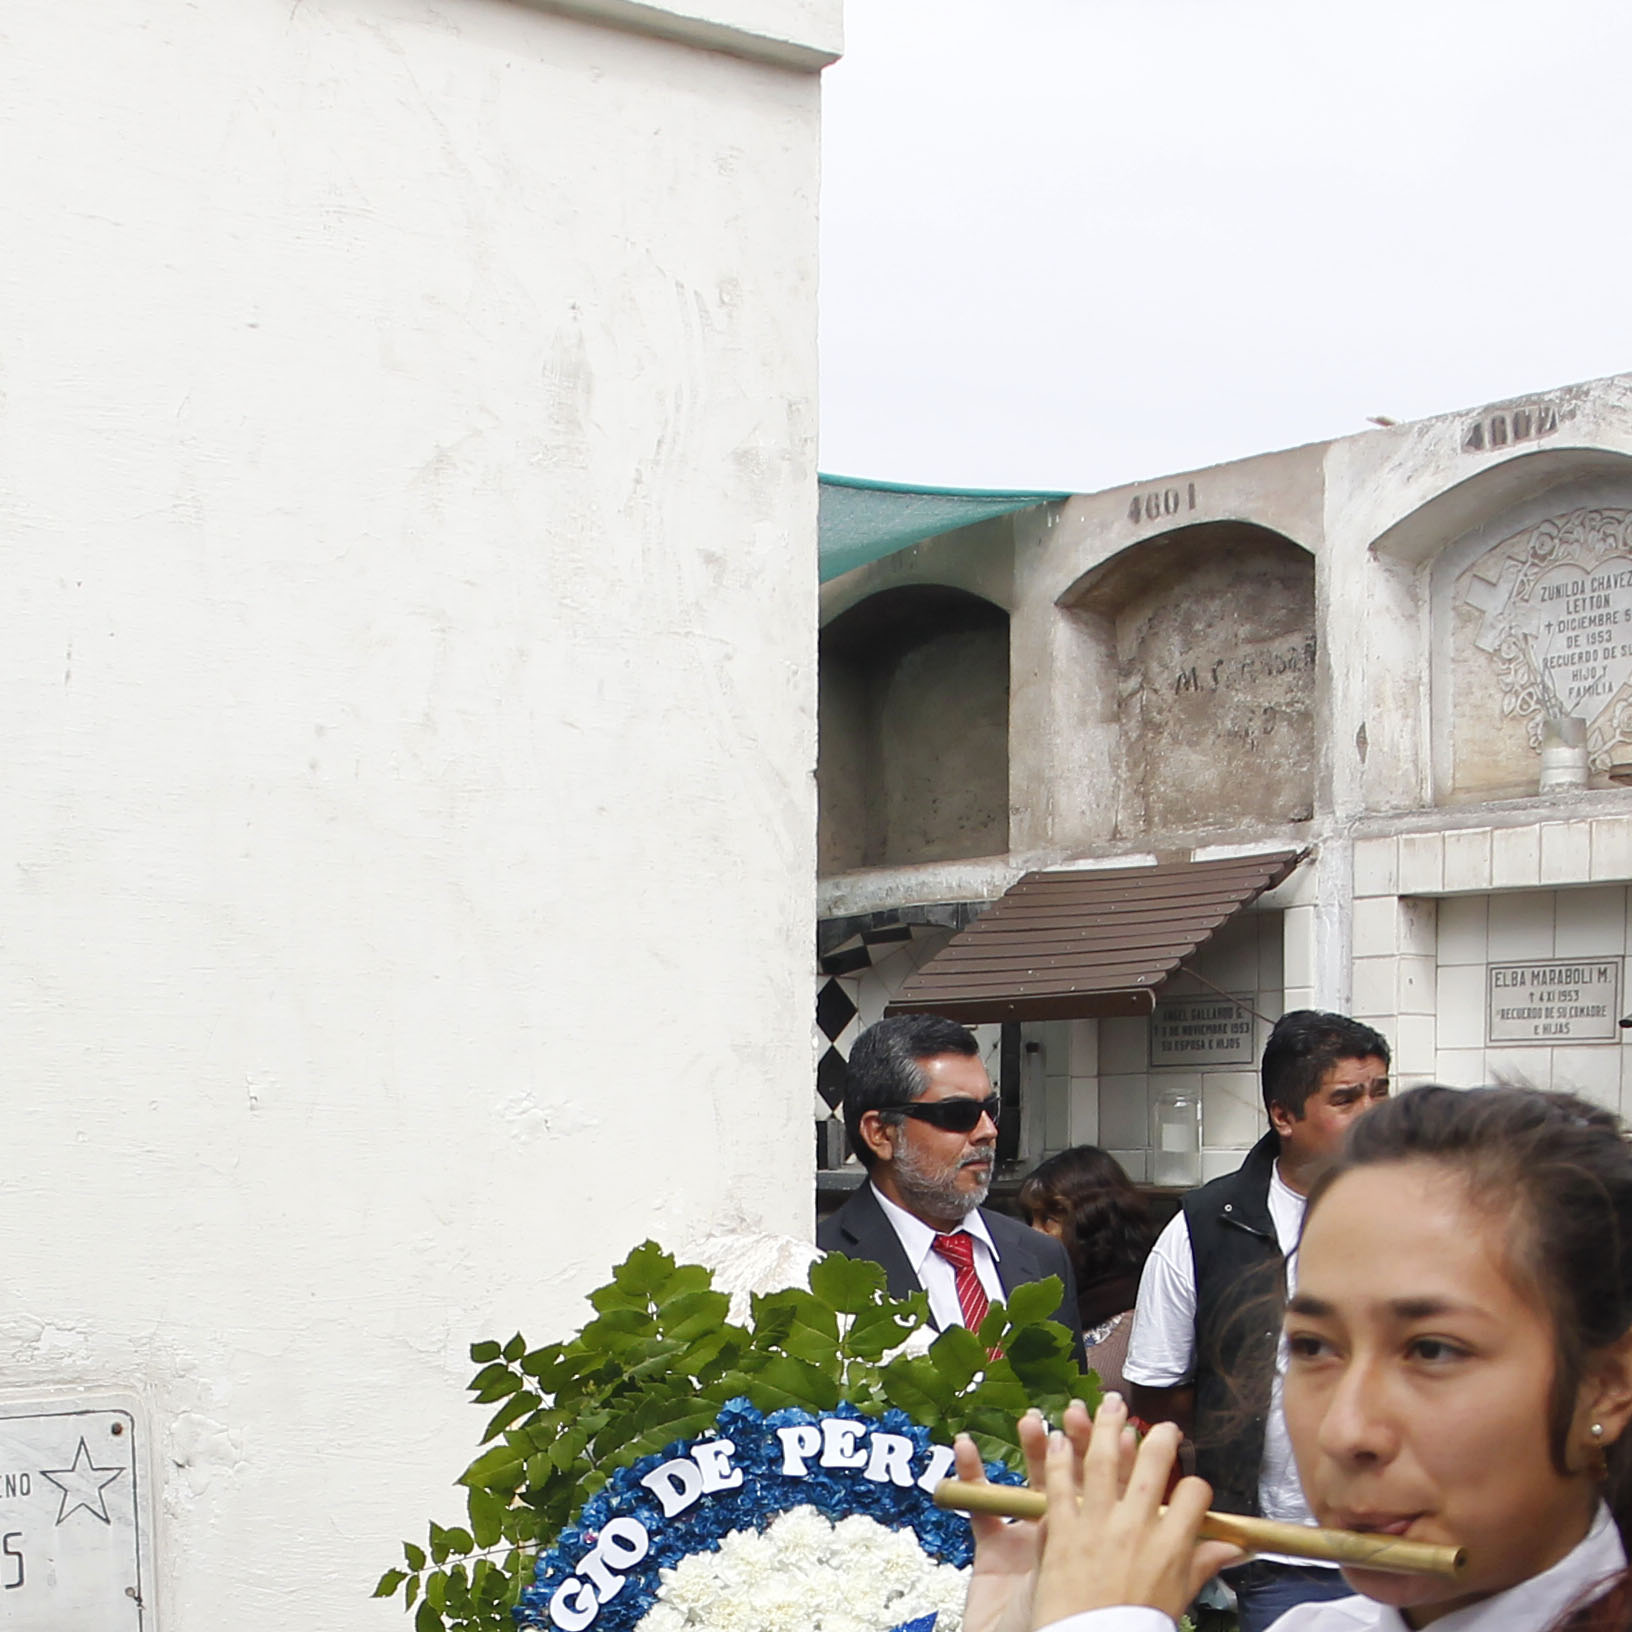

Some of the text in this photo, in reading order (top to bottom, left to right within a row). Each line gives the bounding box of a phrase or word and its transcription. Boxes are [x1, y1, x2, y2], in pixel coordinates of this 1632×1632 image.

[1540, 580, 1586, 602] ZUNILDA
[1566, 593, 1611, 615] LEYTON
[1558, 609, 1632, 633] DICIEMBRE 5
[1566, 630, 1613, 649] DE 1953
[1542, 649, 1599, 669] RECUERDO
[1603, 646, 1617, 660] DE
[1571, 666, 1598, 682] HIJO
[1568, 681, 1614, 699] FAMILIA
[1494, 967, 1613, 988] ELBA MARABOLI M.
[1558, 989, 1580, 1002] 1953
[1544, 1006, 1555, 1019] DE
[1542, 1023, 1570, 1035] HIJAS
[641, 1438, 744, 1519] DE
[777, 1418, 958, 1494] PERI
